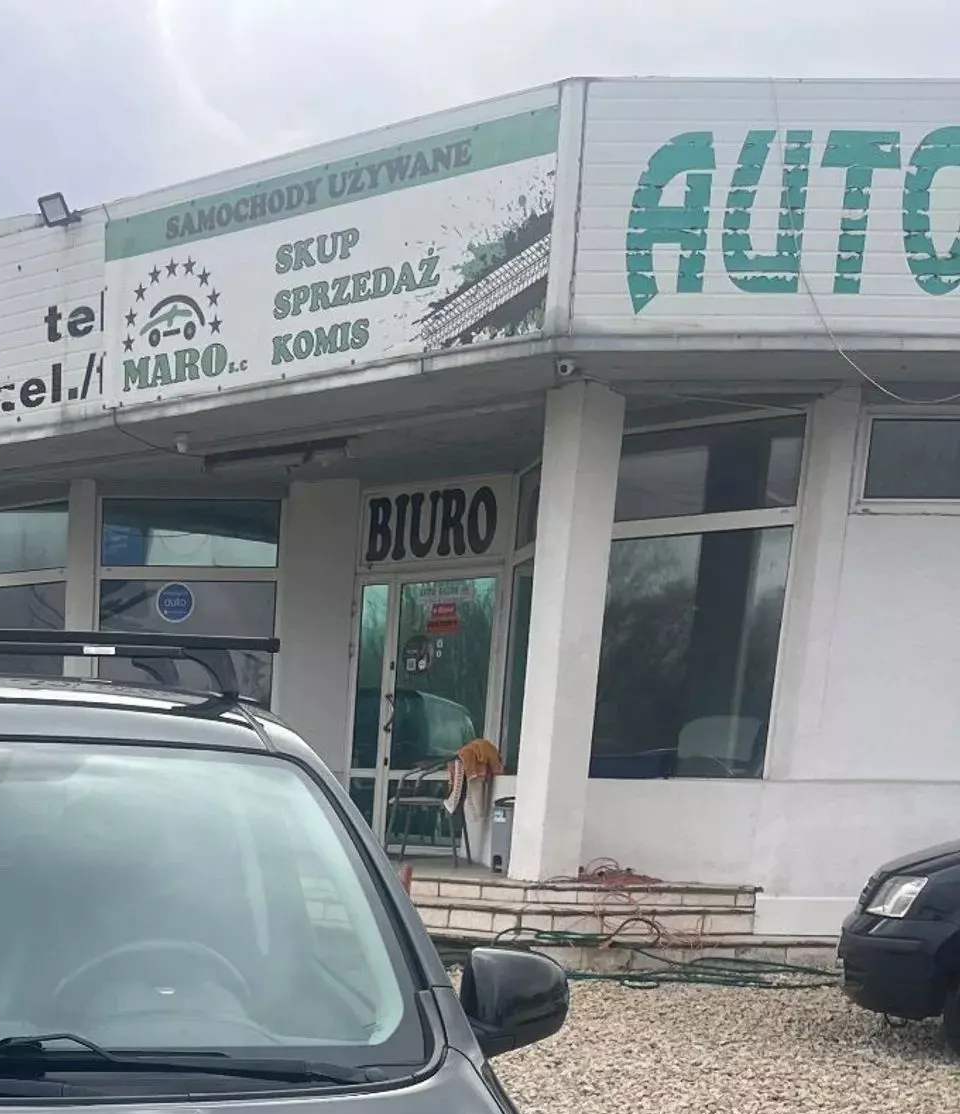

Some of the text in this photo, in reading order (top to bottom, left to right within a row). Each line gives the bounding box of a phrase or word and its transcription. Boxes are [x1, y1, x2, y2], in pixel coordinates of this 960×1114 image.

[165, 138, 472, 239] SAMOCHODY UŻYWANE
[626, 126, 960, 315] AUTO
[273, 248, 440, 320] SPRZEDAŻ
[275, 227, 359, 274] SKUP
[122, 343, 228, 392] MARO
[271, 318, 370, 366] KOMIS
[365, 486, 498, 562] BIURO
